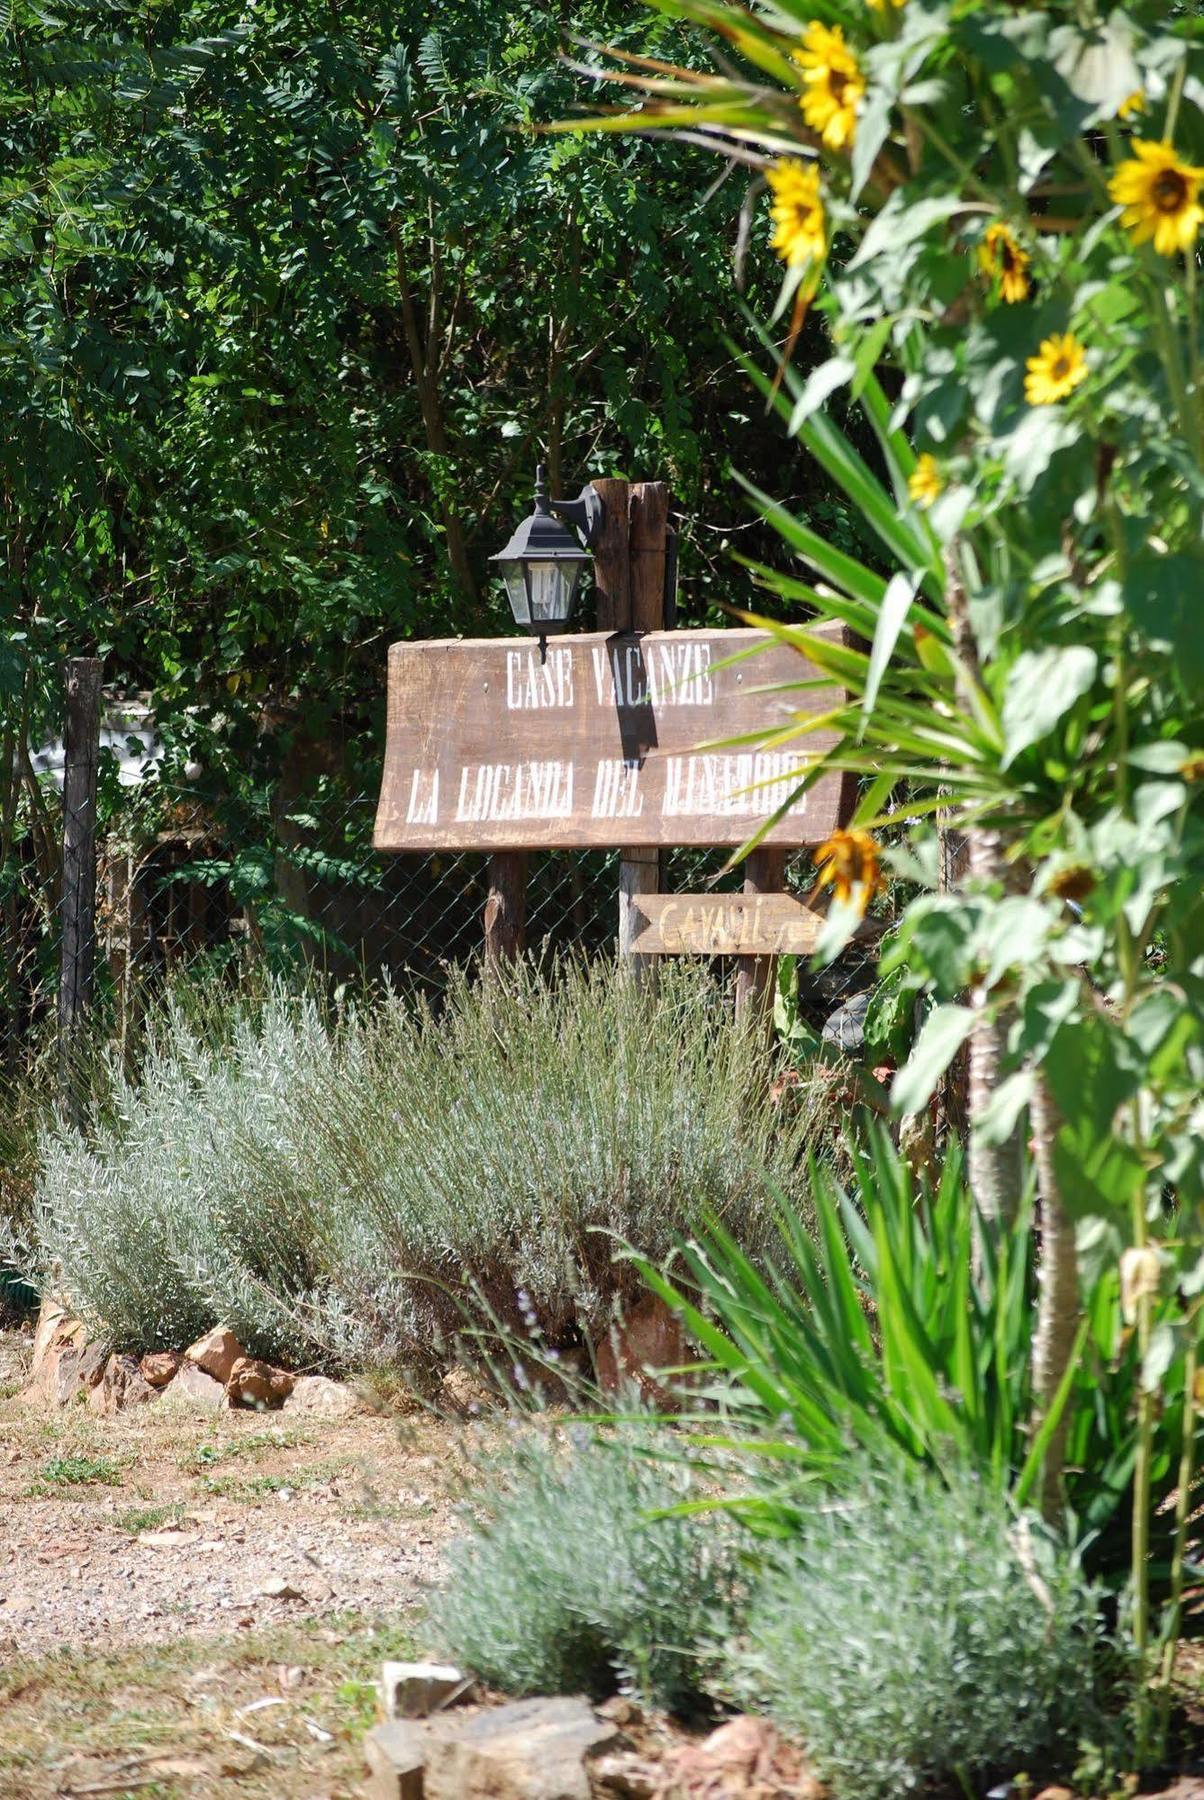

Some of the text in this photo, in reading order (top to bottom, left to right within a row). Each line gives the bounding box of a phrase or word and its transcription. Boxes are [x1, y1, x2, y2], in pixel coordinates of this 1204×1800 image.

[507, 644, 713, 710] CASE VACANZE
[406, 768, 439, 824] LA
[454, 760, 573, 822] LOCANDA
[591, 759, 644, 818] DEL
